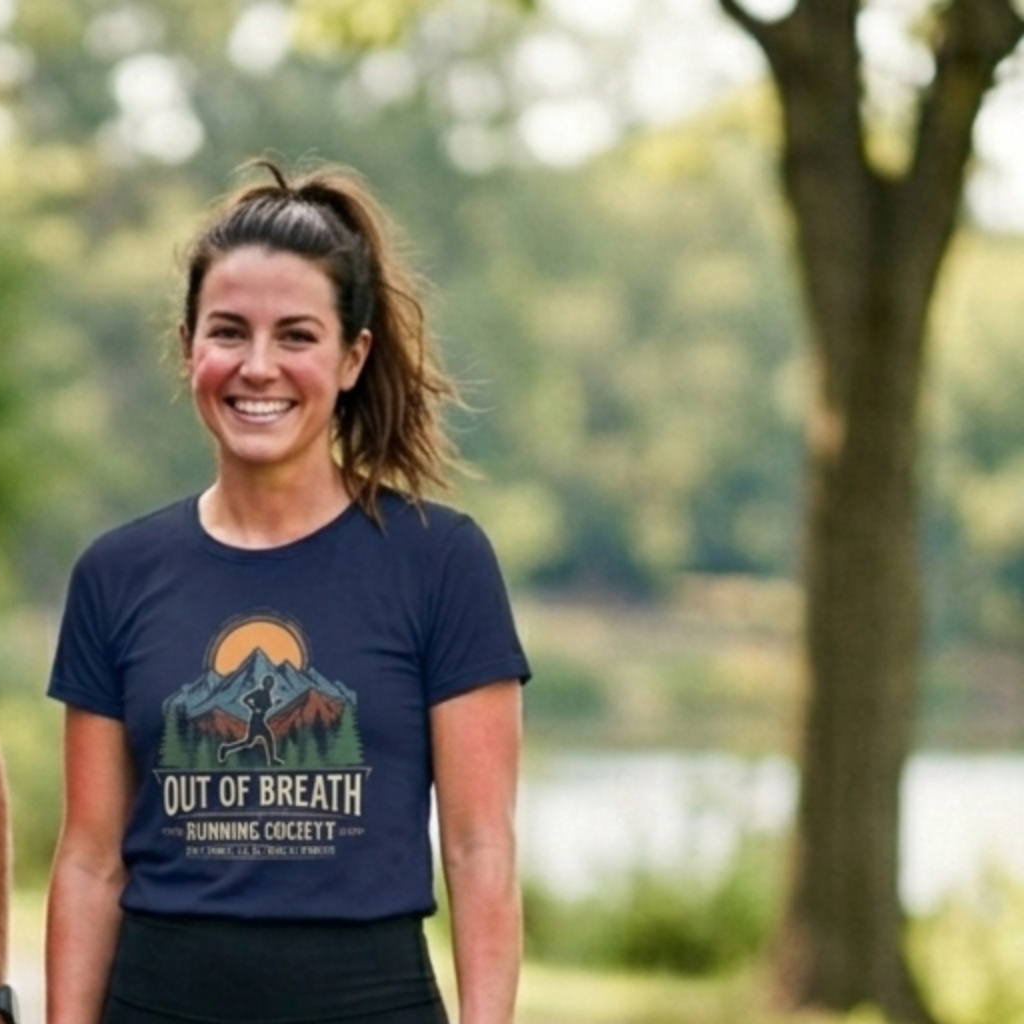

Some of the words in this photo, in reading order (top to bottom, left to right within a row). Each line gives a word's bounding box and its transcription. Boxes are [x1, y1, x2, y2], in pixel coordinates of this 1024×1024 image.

[163, 775, 211, 816] OUT
[219, 775, 251, 807] OF
[259, 773, 361, 816] BREATH
